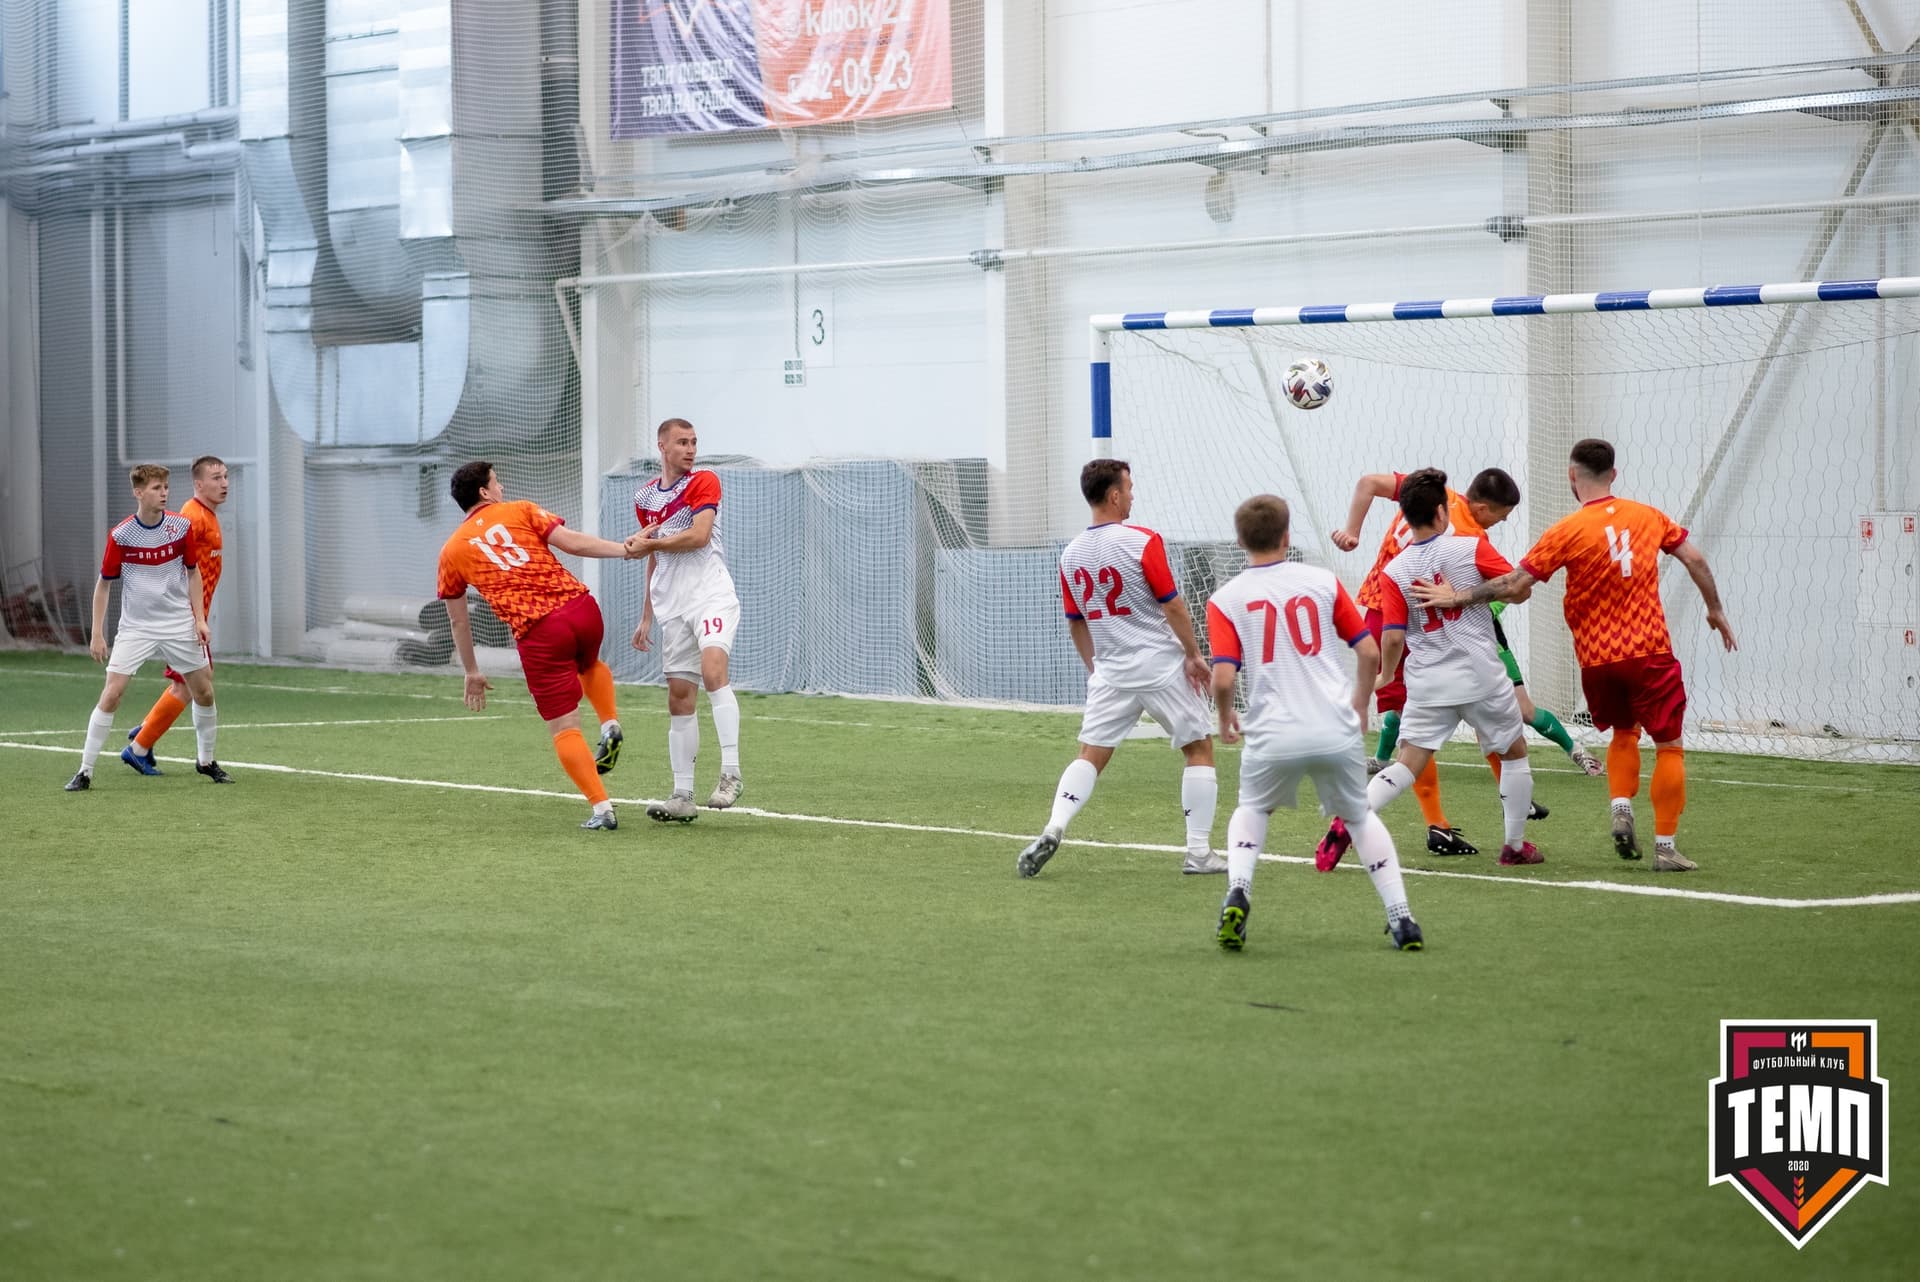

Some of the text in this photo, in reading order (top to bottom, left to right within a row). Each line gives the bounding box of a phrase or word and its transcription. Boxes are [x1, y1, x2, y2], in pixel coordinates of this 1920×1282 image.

[811, 308, 825, 346] 3
[468, 523, 530, 571] 13
[1604, 525, 1633, 577] 4
[1074, 566, 1132, 620] 22
[703, 617, 723, 636] 19
[1246, 595, 1322, 664] 70
